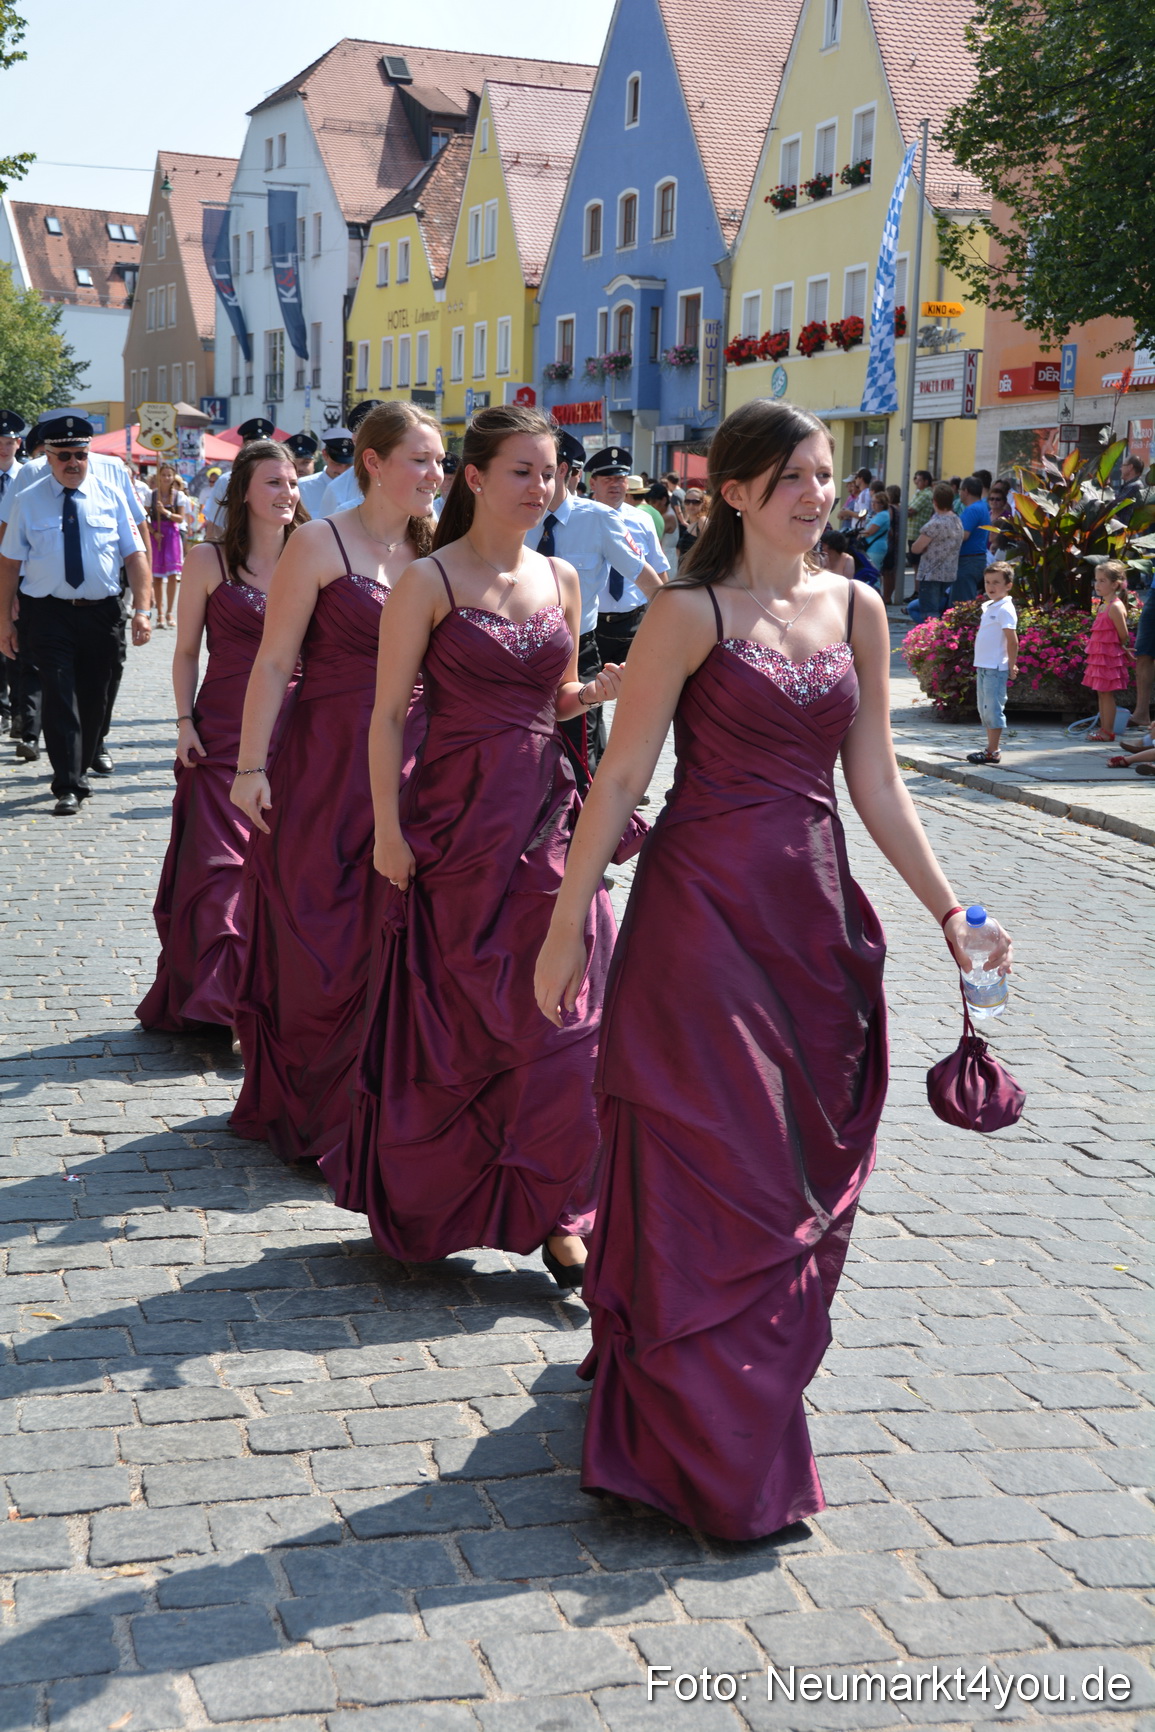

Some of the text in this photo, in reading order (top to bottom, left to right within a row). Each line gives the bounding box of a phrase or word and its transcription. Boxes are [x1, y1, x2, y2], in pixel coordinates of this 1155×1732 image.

[275, 252, 299, 303] K&L
[387, 308, 409, 330] HOTEL
[927, 304, 947, 315] KINO
[705, 337, 718, 403] WITTL
[1037, 370, 1060, 382] DER
[1063, 350, 1074, 385] P
[919, 379, 955, 394] RIALTO KINO
[965, 353, 976, 414] KINO
[998, 379, 1012, 393] DER
